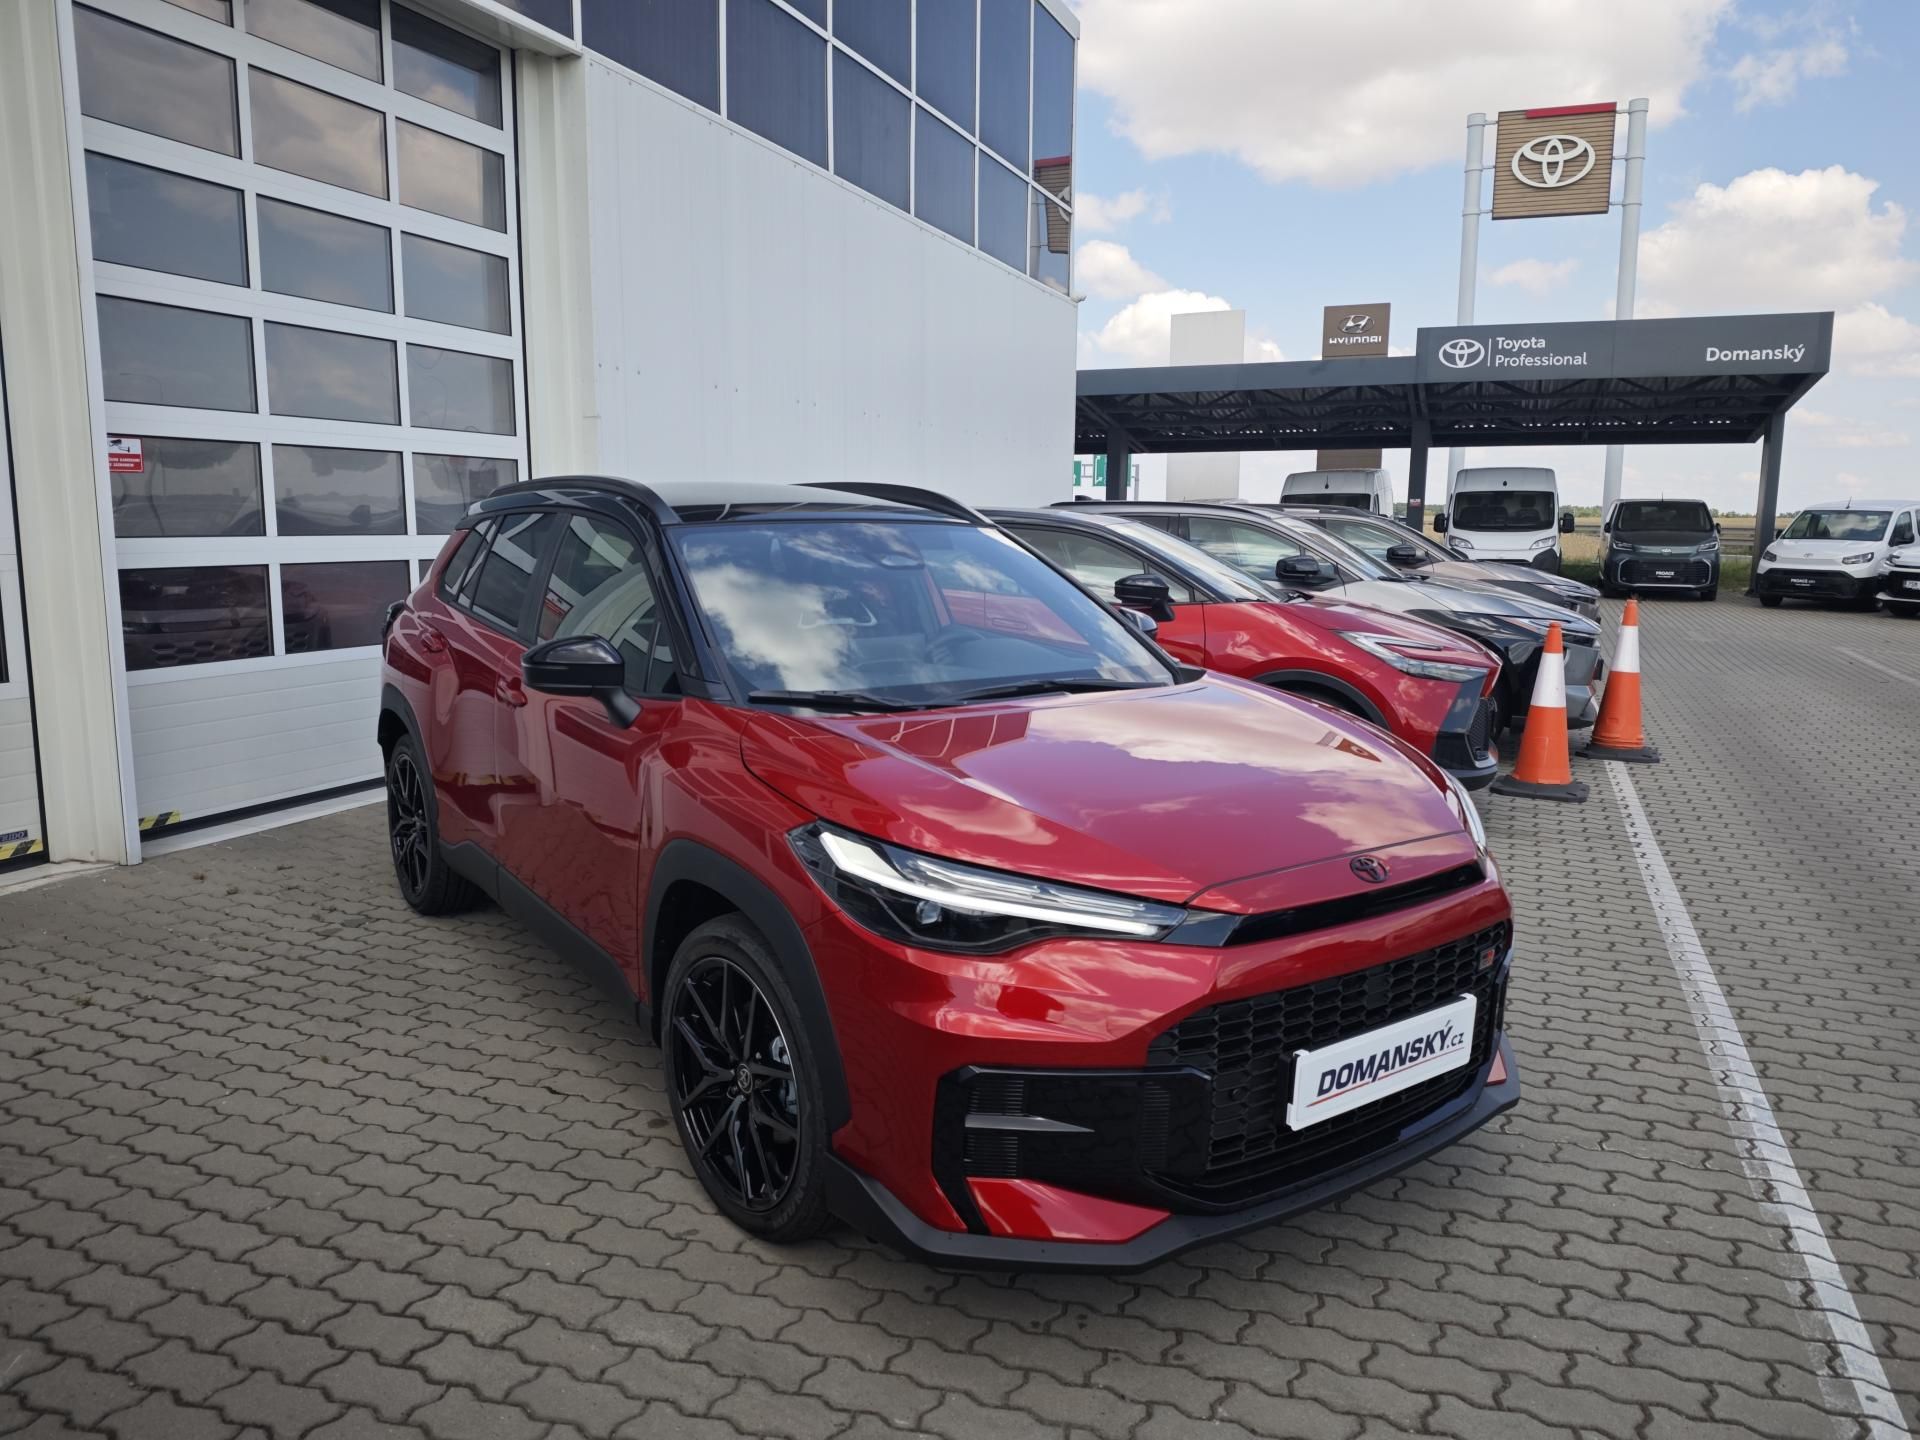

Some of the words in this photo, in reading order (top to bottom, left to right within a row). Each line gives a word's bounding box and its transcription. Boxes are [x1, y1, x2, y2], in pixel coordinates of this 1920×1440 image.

[1328, 335, 1382, 345] HYUNDAI
[1496, 336, 1546, 352] Toyota
[1495, 352, 1588, 367] Professional
[1705, 344, 1806, 363] Domanský
